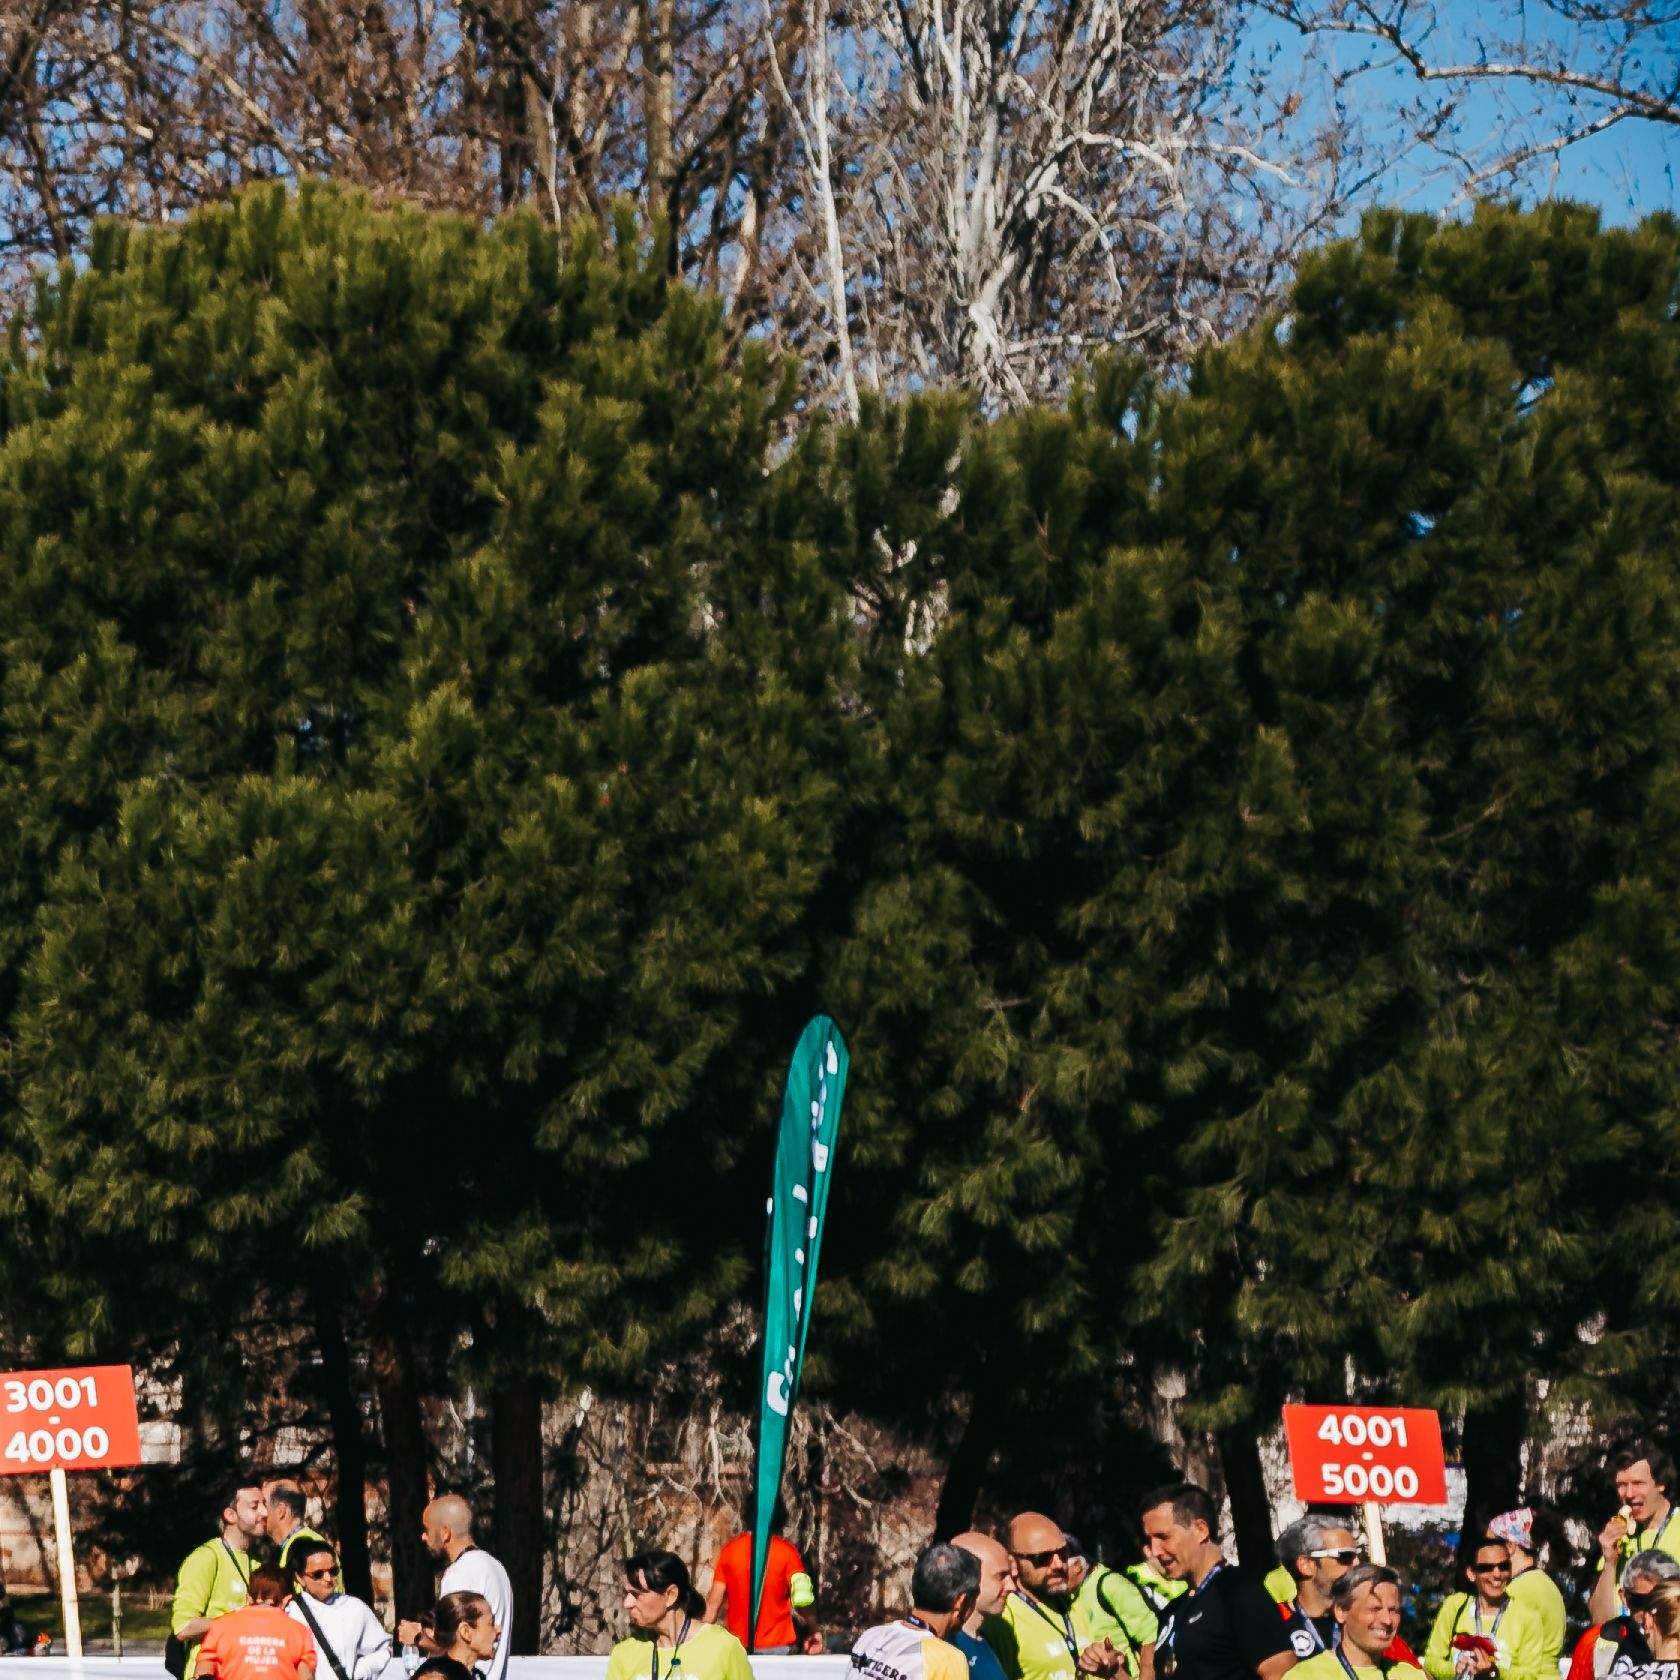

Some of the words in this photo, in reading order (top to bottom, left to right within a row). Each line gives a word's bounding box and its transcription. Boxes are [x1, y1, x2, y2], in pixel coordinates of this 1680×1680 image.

[4, 1376, 98, 1414] 3001
[4, 1426, 110, 1464] 4000
[1317, 1413, 1408, 1448] 4001
[1321, 1462, 1419, 1499] 5000
